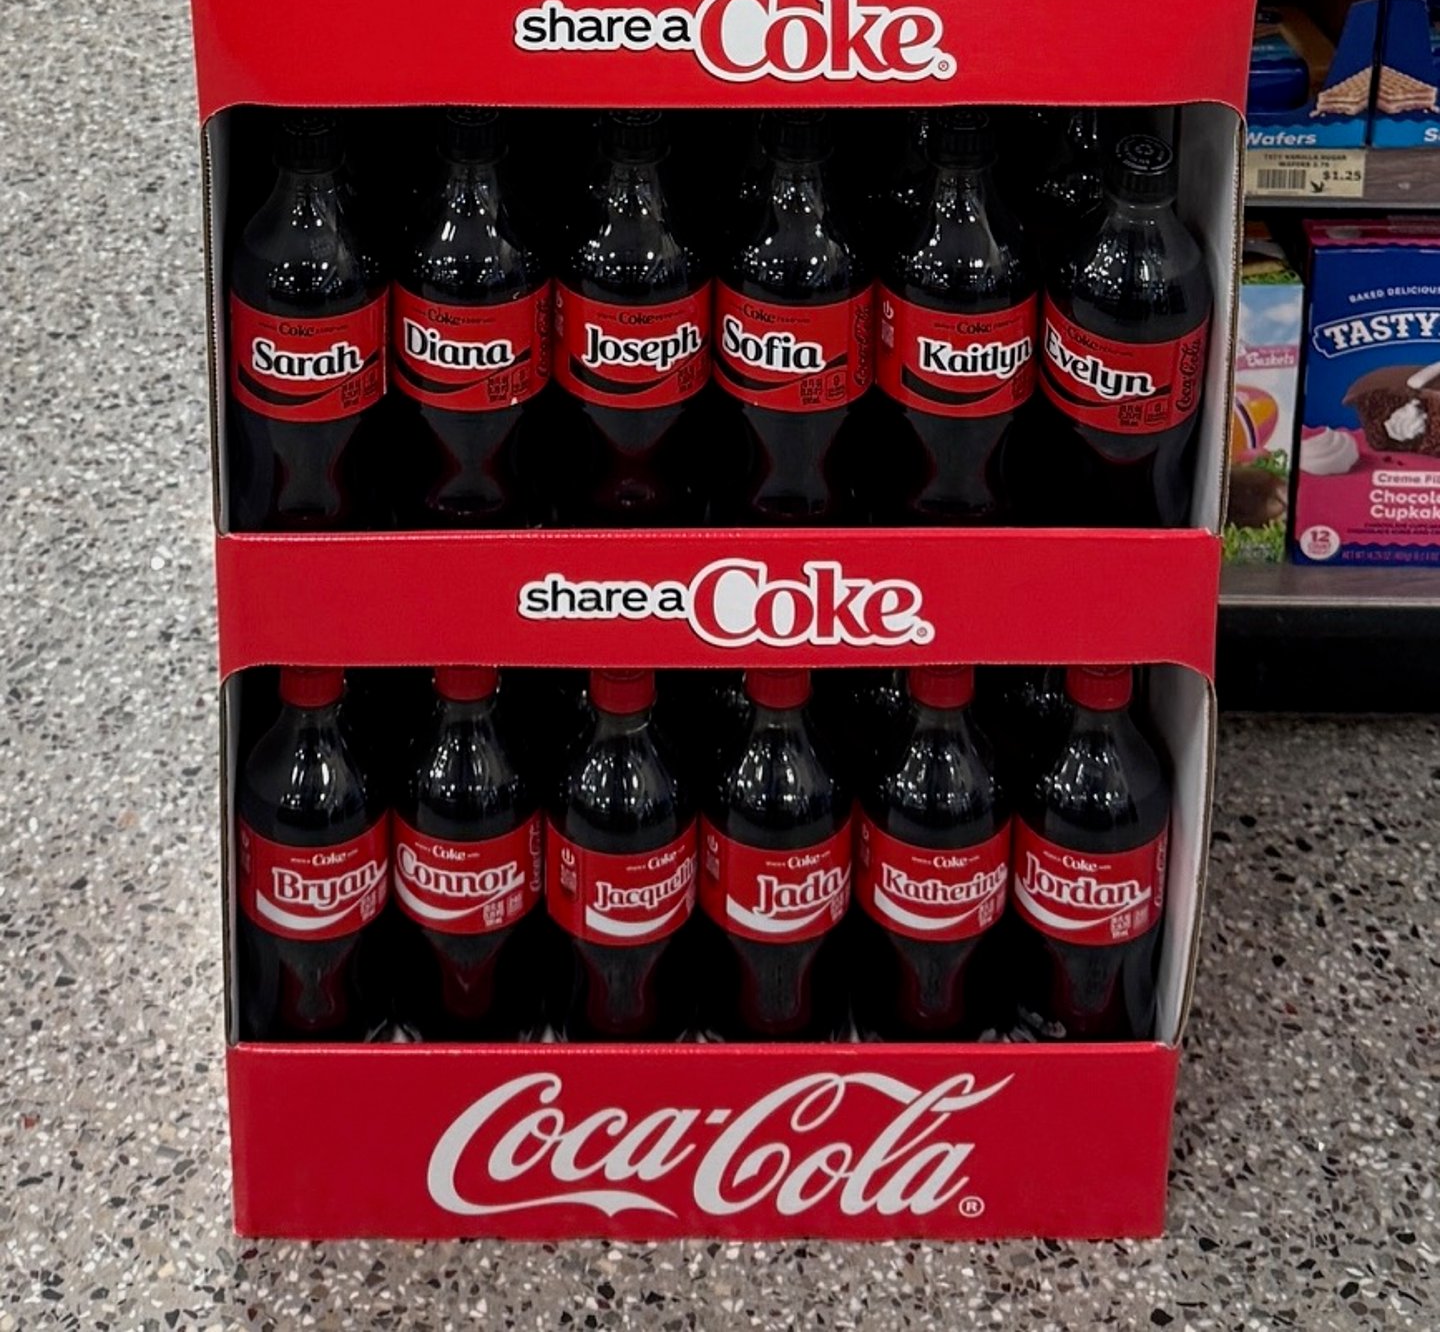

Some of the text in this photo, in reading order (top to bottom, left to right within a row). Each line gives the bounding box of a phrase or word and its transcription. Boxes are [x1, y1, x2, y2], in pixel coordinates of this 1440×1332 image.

[521, 7, 653, 45] share
[661, 14, 692, 44] a
[1246, 131, 1318, 146] Wafers
[1348, 288, 1386, 304] BAKED
[428, 307, 462, 327] Coke
[618, 309, 657, 326] Coke
[742, 302, 777, 326] Coke
[405, 320, 512, 367] Diana
[584, 325, 700, 370] Joseph
[724, 316, 822, 370] Sofia
[254, 340, 360, 377] Sarah
[920, 339, 1032, 378] Kaitlyn
[1045, 320, 1152, 399] Evelyn
[1378, 472, 1421, 484] Creme
[1310, 530, 1330, 543] 12
[525, 579, 649, 614] share
[657, 586, 686, 613] a
[312, 851, 347, 867] Coke
[432, 844, 467, 861] Coke
[647, 851, 677, 871] Coke
[786, 853, 820, 870] Coke
[932, 856, 968, 869] Coke
[1062, 856, 1098, 873] Coke
[399, 846, 517, 896] Connor
[1025, 852, 1138, 909] Jordan
[274, 862, 376, 908] Bryan
[756, 866, 844, 916] Jada
